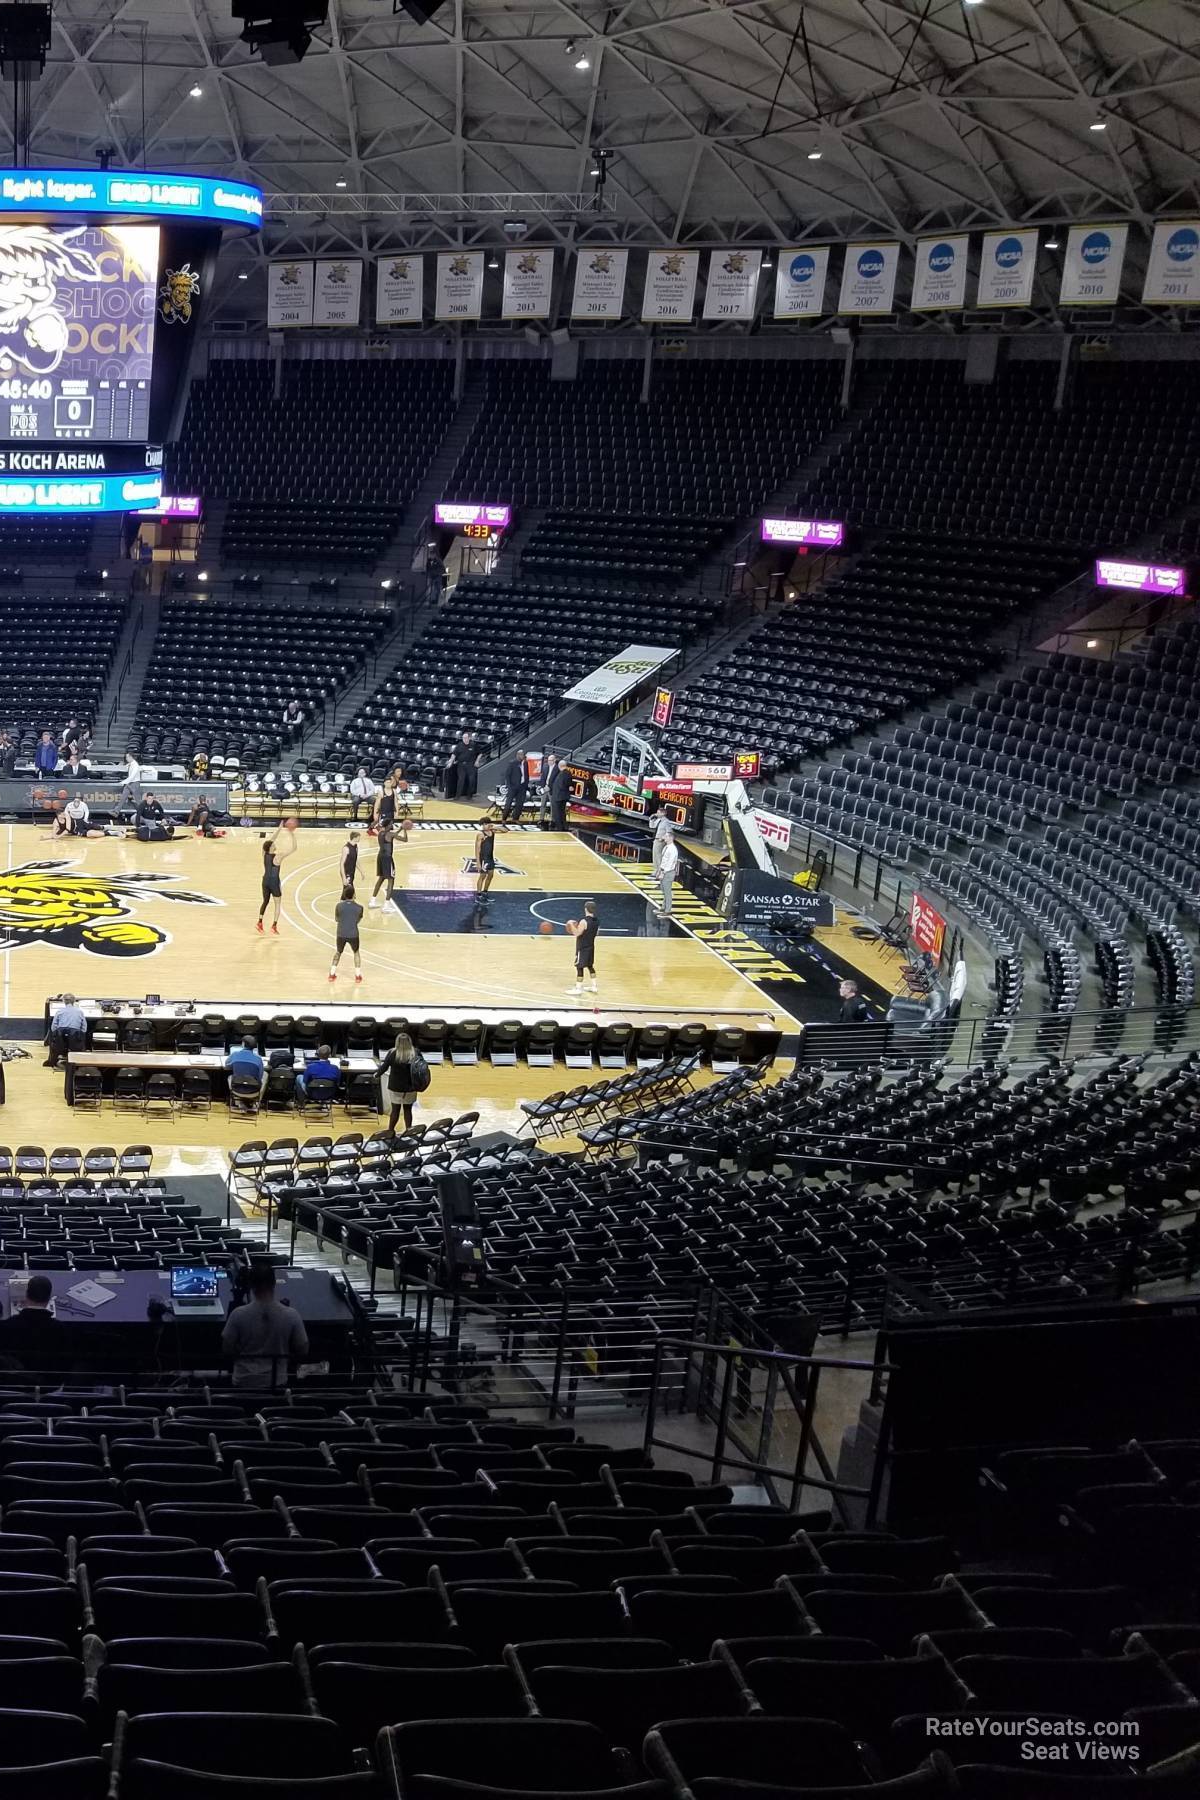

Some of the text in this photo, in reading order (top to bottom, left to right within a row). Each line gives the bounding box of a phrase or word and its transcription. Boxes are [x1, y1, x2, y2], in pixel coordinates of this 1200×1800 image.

[3, 178, 44, 202] light
[1083, 247, 1111, 257] NCAA
[1170, 245, 1198, 254] NCAA
[997, 252, 1022, 261] NCAA
[930, 257, 954, 266] NCAA
[860, 263, 884, 272] NCAA
[792, 268, 815, 277] NCAA
[993, 287, 1017, 298] 2009
[1078, 285, 1103, 295] 2010
[1162, 284, 1189, 294] 2011
[855, 297, 879, 306] 2007
[927, 292, 950, 302] 2008
[448, 304, 468, 313] 2008
[516, 303, 535, 311] 2013
[587, 303, 607, 311] 2015
[657, 305, 678, 314] 2016
[718, 305, 739, 313] 2017
[789, 301, 808, 310] 2004
[280, 312, 300, 320] 2004
[326, 311, 346, 320] 2005
[390, 308, 409, 317] 2007
[68, 400, 81, 420] 0
[9, 452, 51, 470] KOCH
[56, 452, 106, 469] ARENA
[36, 482, 102, 506] LIGHT
[464, 525, 488, 537] 4:33
[739, 763, 753, 773] 23
[659, 789, 693, 807] BEARCATS
[743, 894, 820, 907] KANSAS STAR
[692, 929, 807, 983] STATE
